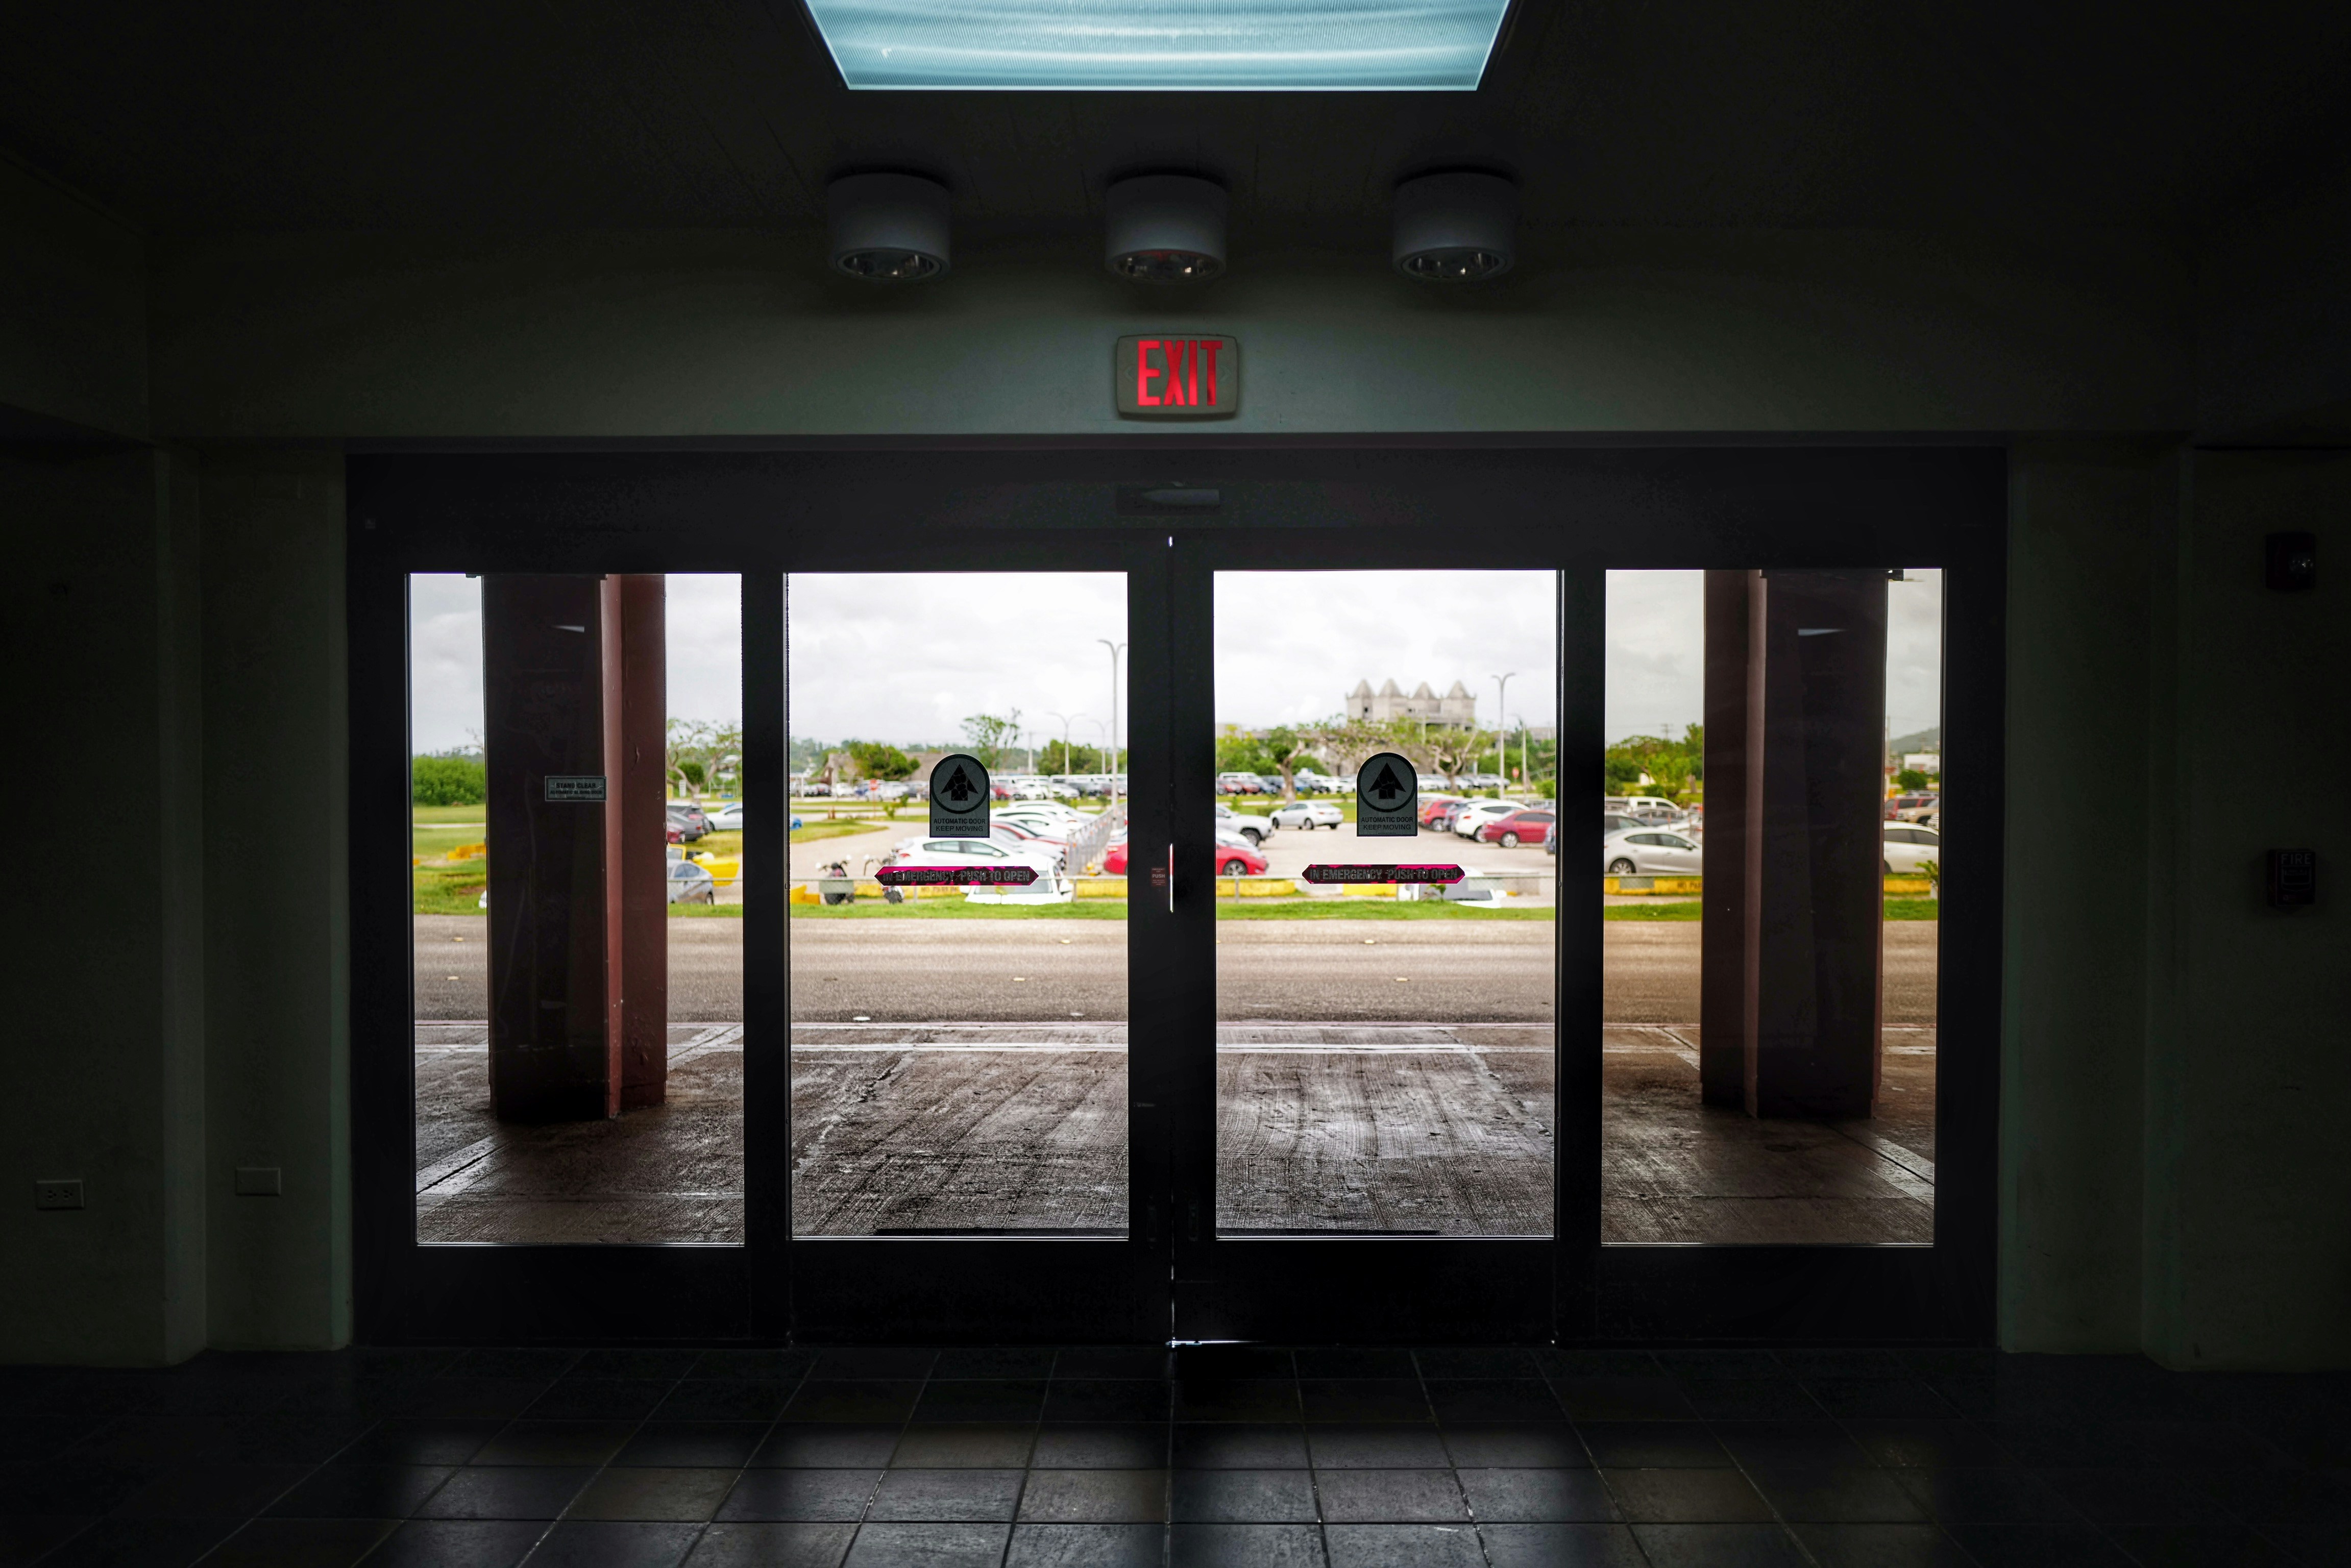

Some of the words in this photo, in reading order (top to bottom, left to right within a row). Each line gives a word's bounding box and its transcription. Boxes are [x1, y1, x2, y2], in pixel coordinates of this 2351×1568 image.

[1137, 340, 1222, 406] EXIT
[2281, 853, 2312, 865] FIRE
[883, 872, 894, 881] IN
[896, 870, 955, 881] EMERGENCY
[961, 870, 987, 881] PUSH
[990, 870, 1001, 881] TO
[1003, 870, 1030, 881] OPEN
[1310, 869, 1320, 879] IN
[1323, 869, 1382, 879] EMERGENCY
[1388, 869, 1414, 879] PUSH
[1416, 869, 1429, 879] TO
[1431, 869, 1458, 879] OPEN
